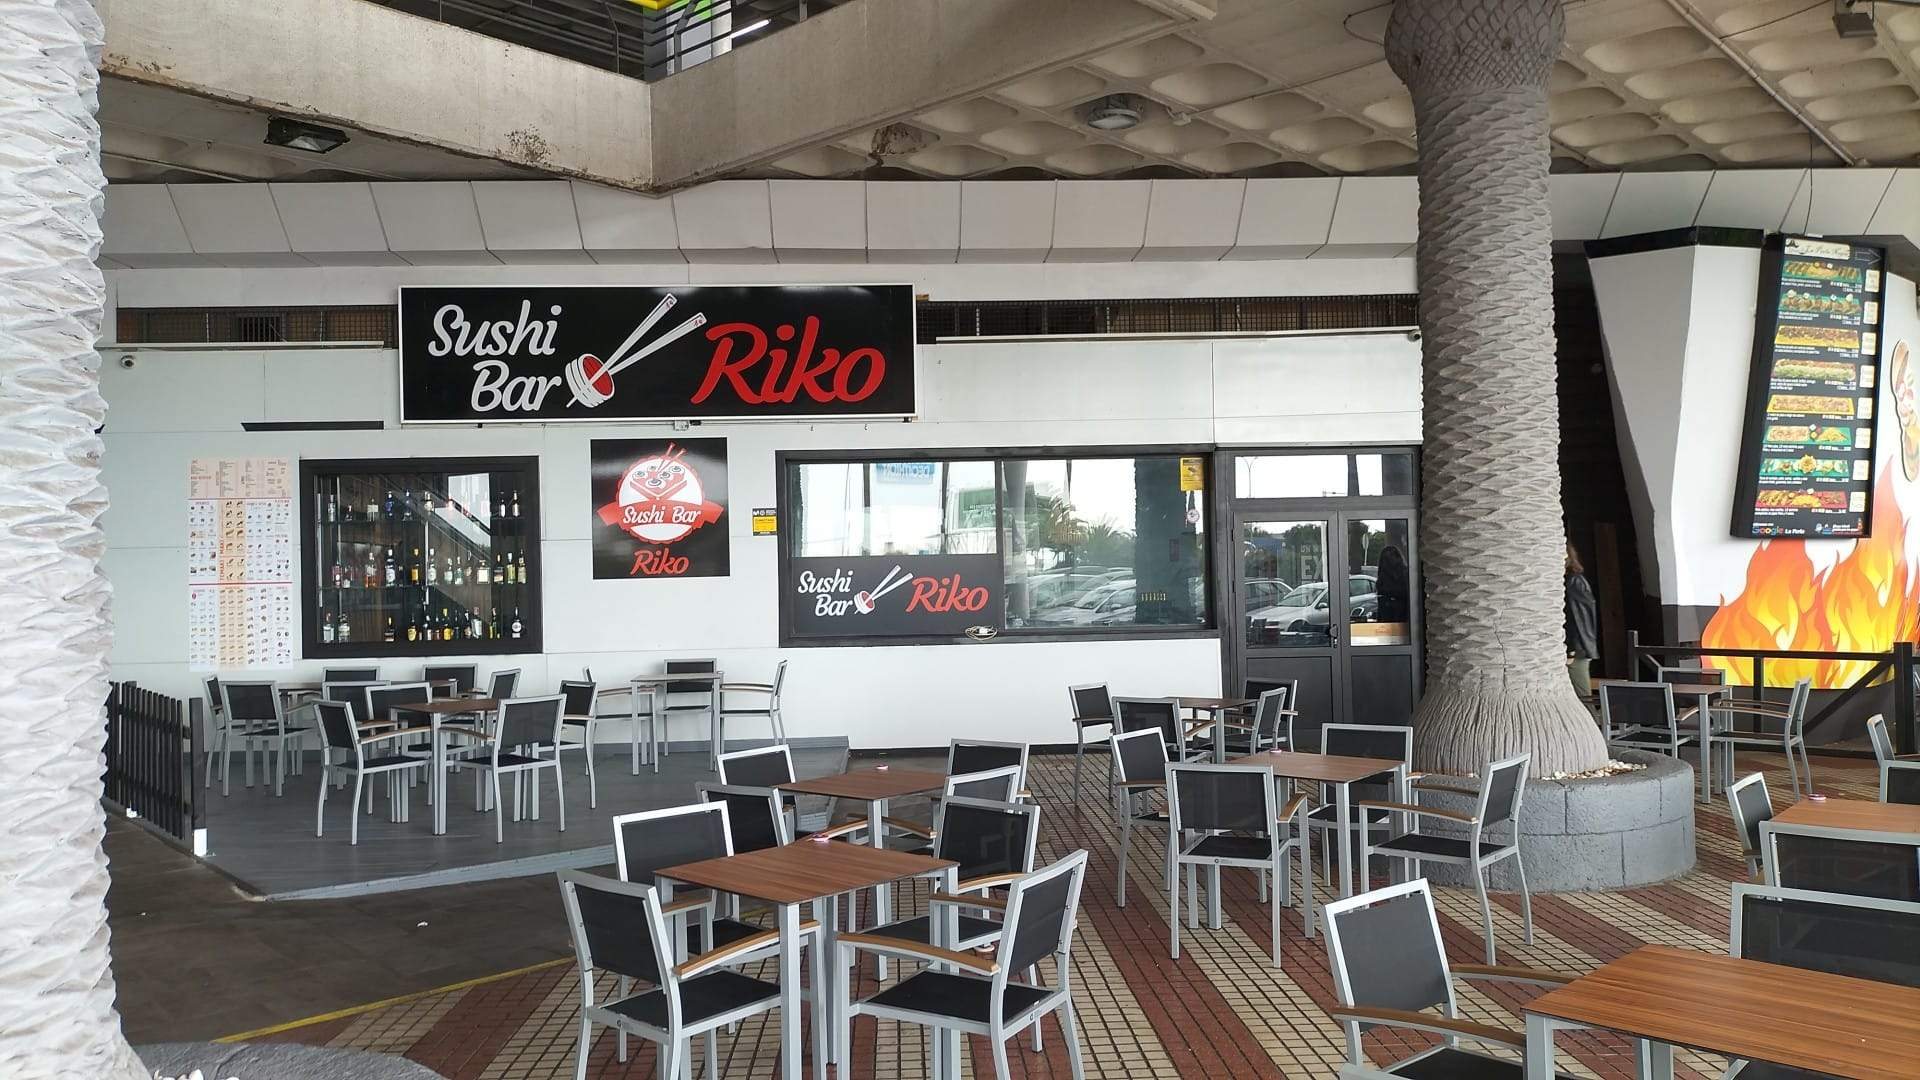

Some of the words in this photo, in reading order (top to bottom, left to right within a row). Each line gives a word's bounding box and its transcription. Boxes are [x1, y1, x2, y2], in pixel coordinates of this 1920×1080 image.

[428, 300, 562, 357] Sushi
[691, 316, 886, 405] Riko
[472, 360, 562, 412] Bar
[622, 504, 667, 524] Sushi
[672, 505, 702, 523] Bar
[630, 547, 690, 577] Riko
[798, 568, 854, 594] Sushi
[906, 574, 990, 613] Riko
[815, 594, 853, 617] Bar
